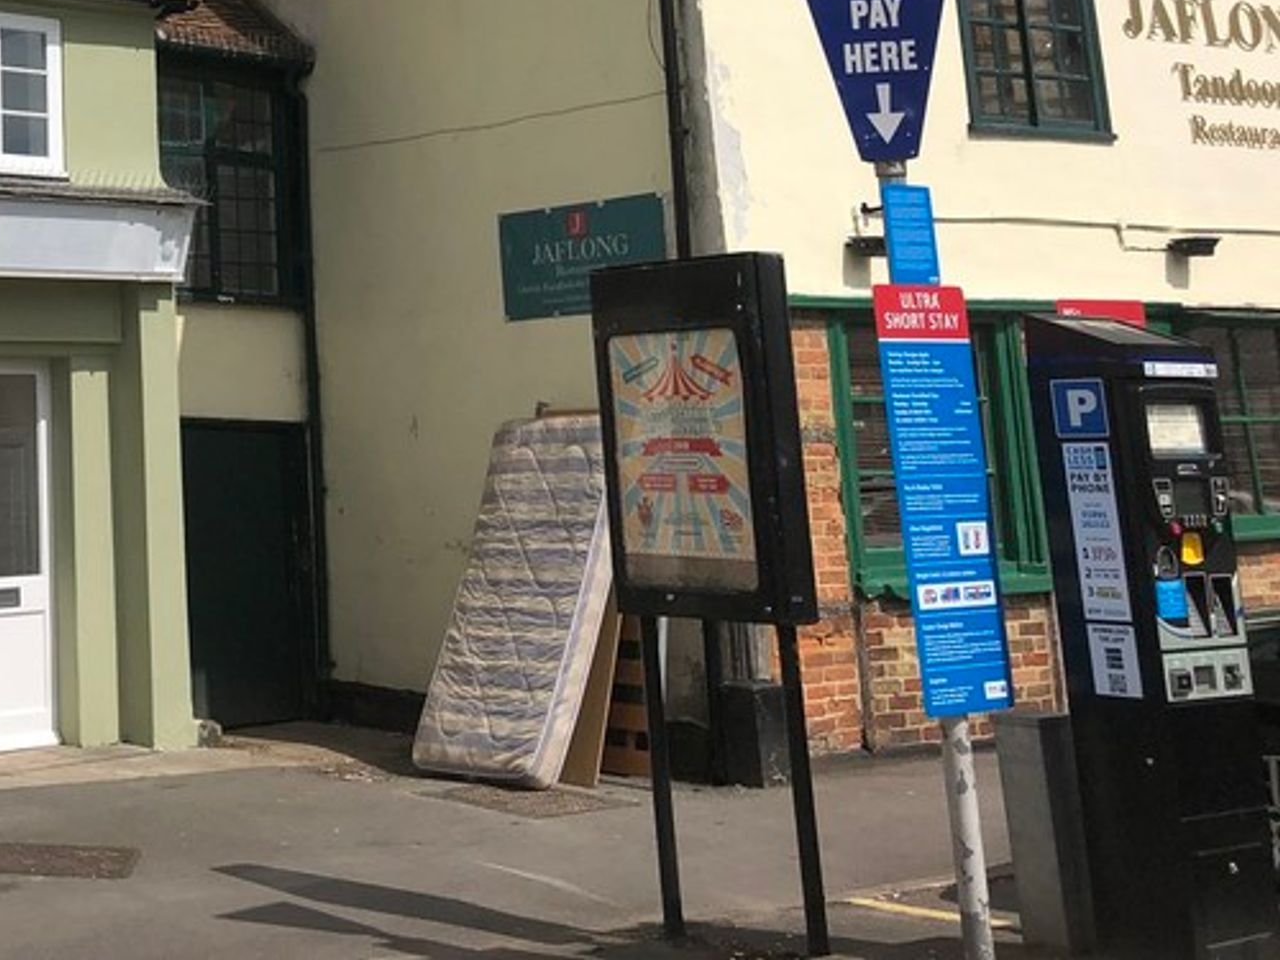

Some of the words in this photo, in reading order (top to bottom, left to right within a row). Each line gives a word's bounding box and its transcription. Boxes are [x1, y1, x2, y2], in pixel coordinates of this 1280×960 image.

[843, 40, 918, 74] HERE
[532, 233, 629, 265] JAFLONG
[899, 292, 940, 309] ULTRA
[884, 312, 925, 330] SHORT
[928, 313, 959, 331] STAY
[1066, 389, 1097, 427] P
[1070, 473, 1090, 482] PAY
[1093, 473, 1107, 482] BY
[1071, 484, 1110, 494] PHONE
